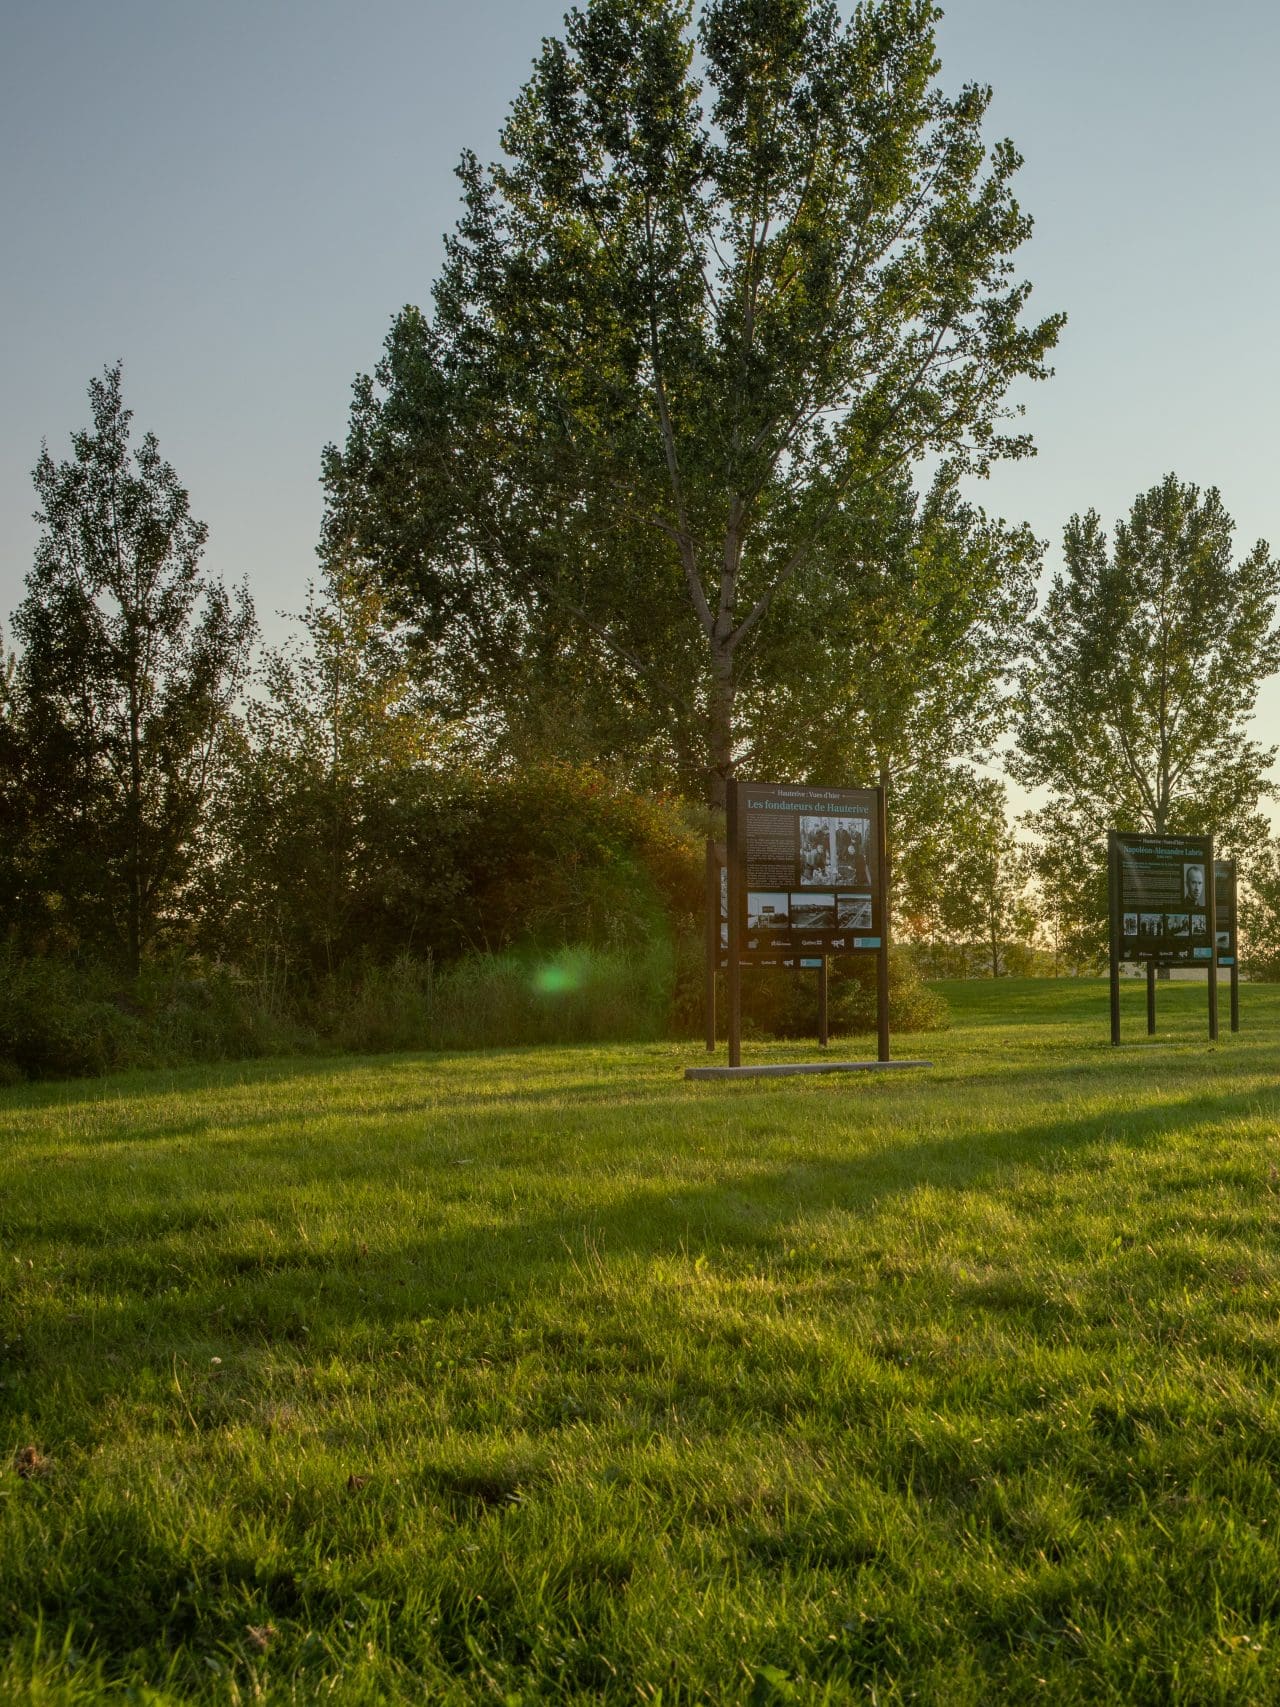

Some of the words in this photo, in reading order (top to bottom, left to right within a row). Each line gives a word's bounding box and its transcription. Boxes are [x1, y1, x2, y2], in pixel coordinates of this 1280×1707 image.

[747, 799, 763, 809] Les
[765, 800, 813, 811] fondateurs
[815, 802, 825, 811] de
[827, 803, 869, 814] Hauterive
